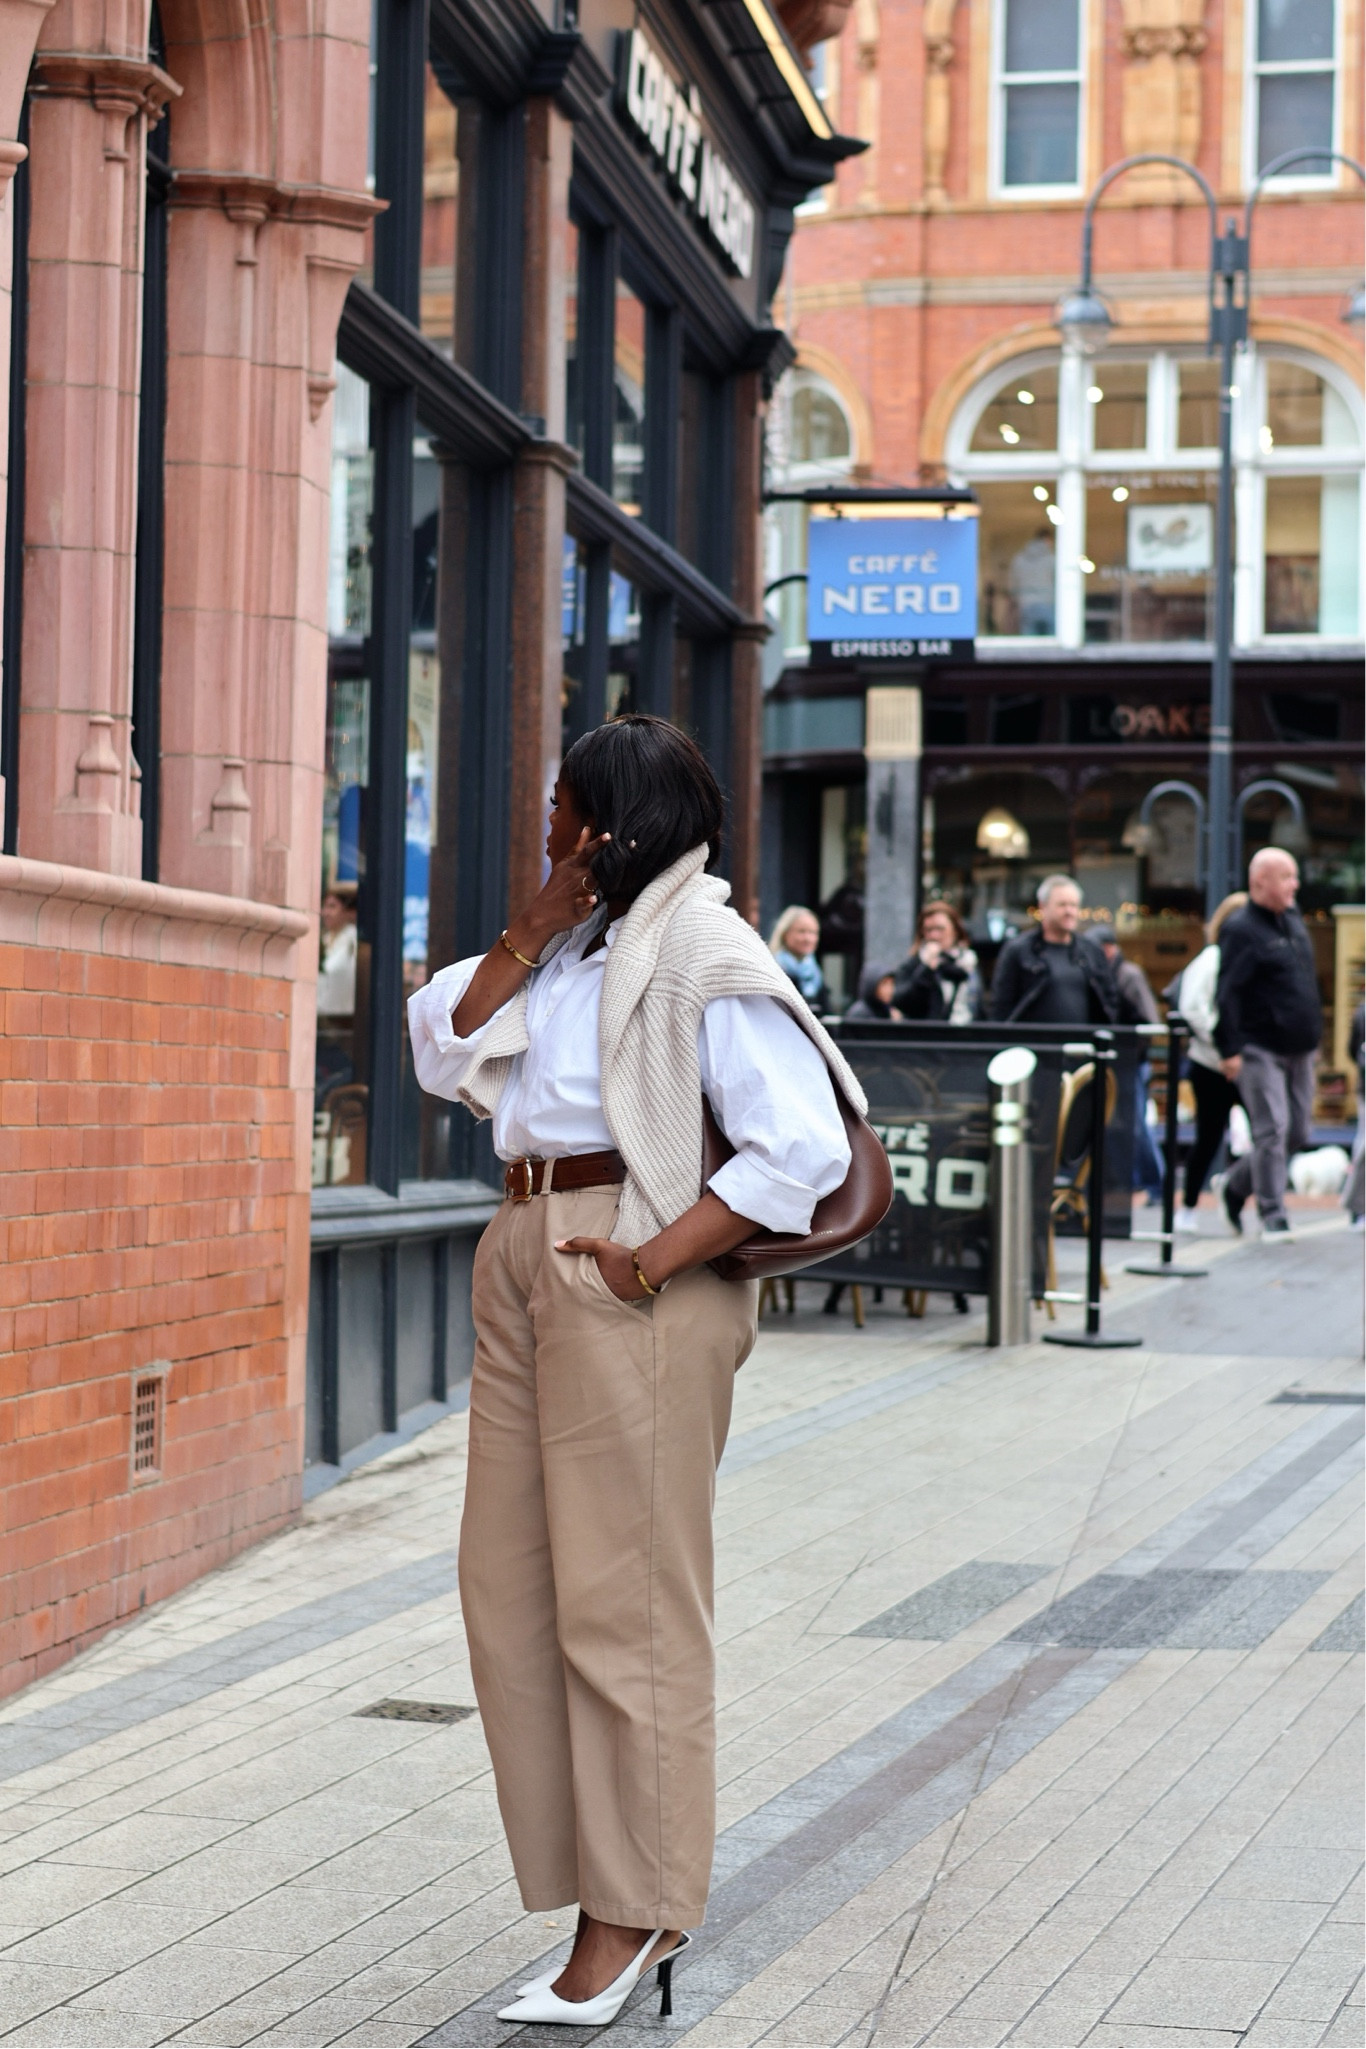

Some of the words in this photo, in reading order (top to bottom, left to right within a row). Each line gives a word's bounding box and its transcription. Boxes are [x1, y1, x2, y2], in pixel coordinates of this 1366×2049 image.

[698, 139, 755, 279] NERO
[823, 584, 961, 615] NERO
[831, 640, 914, 658] ESPRESSO
[918, 640, 951, 657] BAR
[887, 1154, 987, 1210] RO
